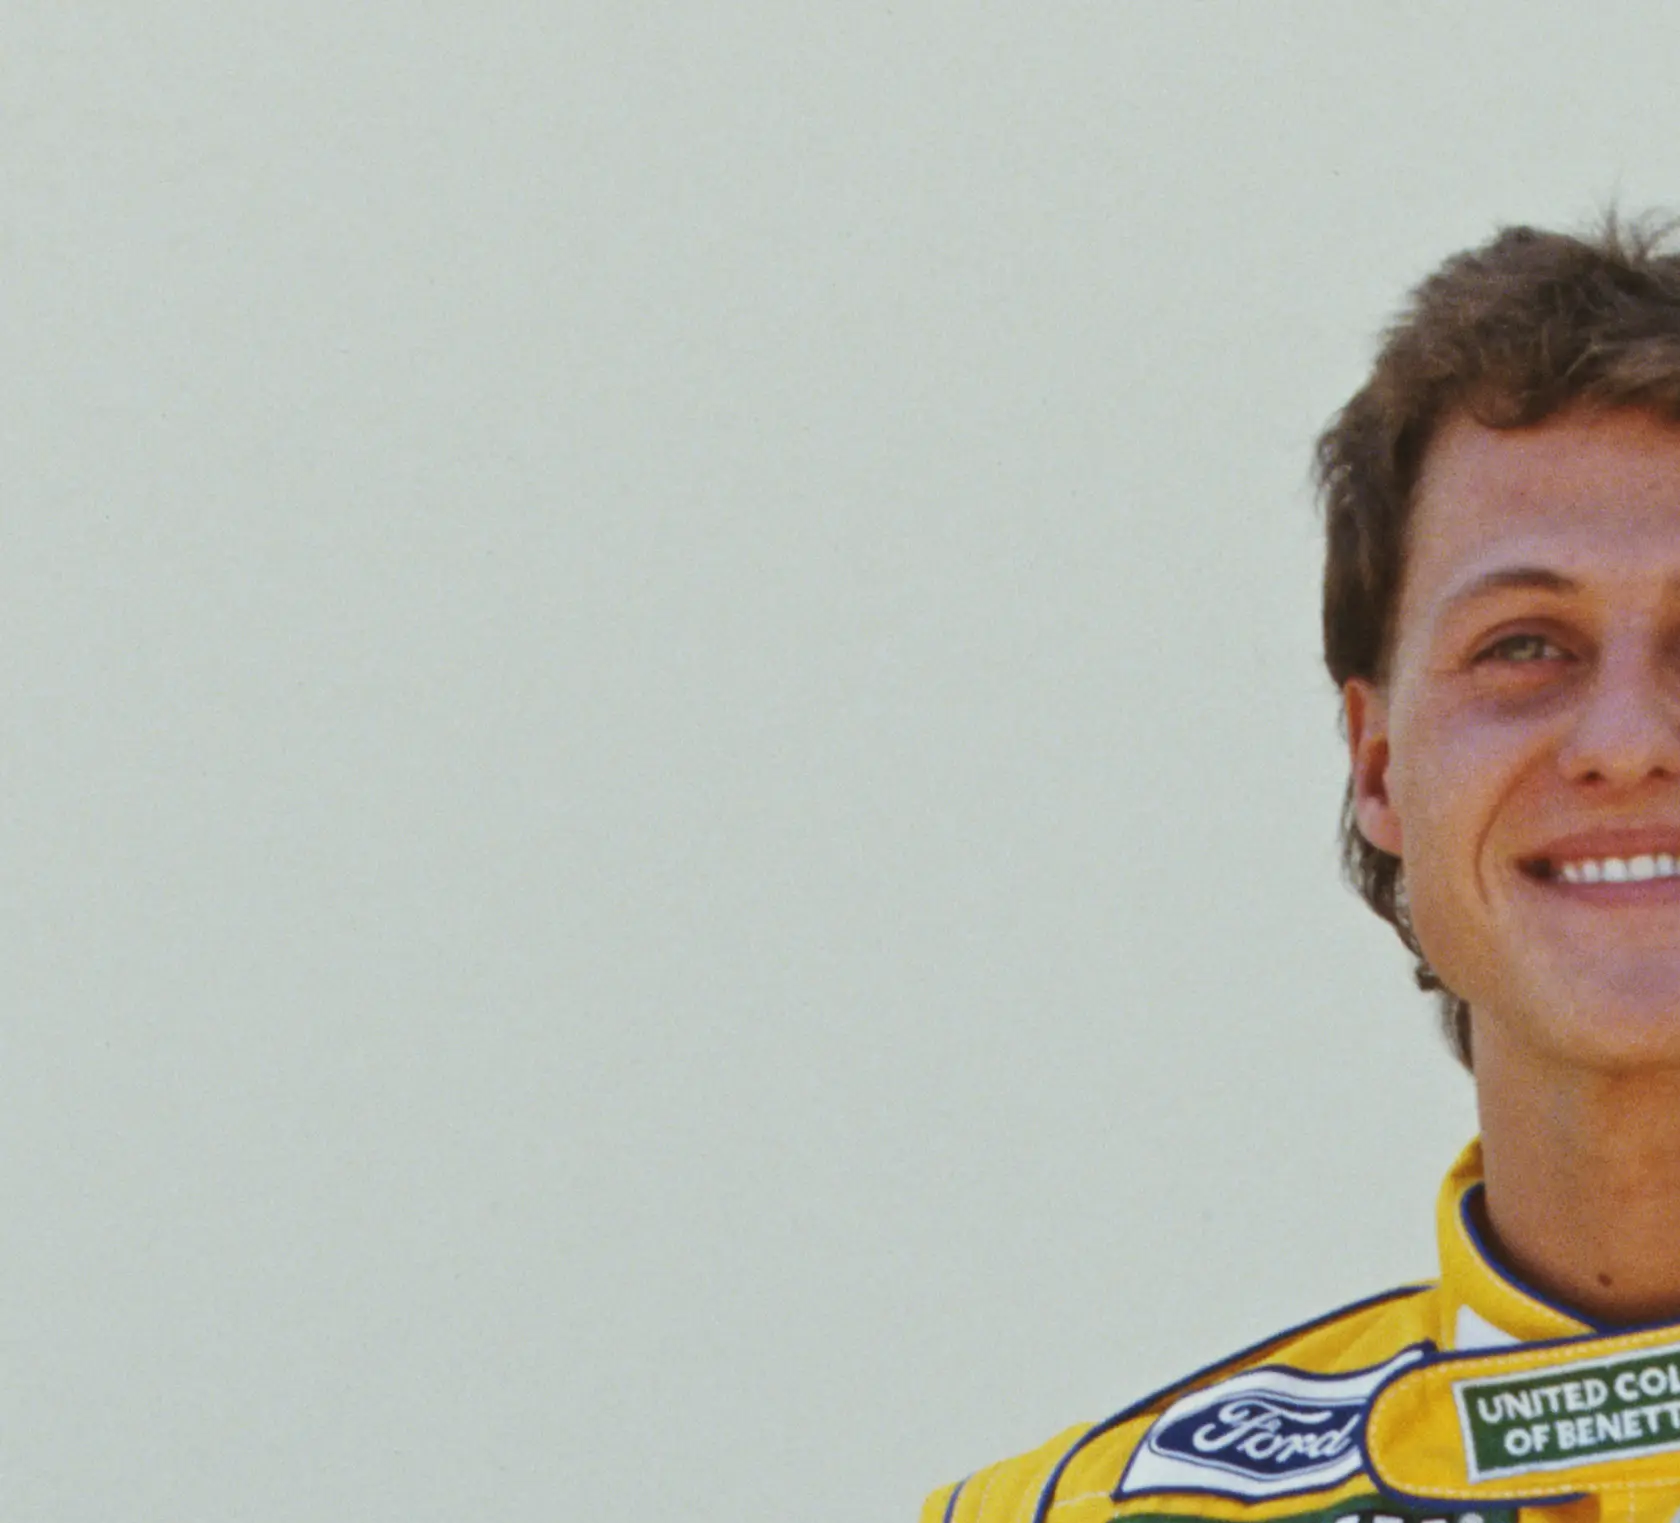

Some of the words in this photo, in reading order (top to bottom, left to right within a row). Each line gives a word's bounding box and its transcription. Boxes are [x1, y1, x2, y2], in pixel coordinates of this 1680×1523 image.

[1478, 1379, 1608, 1423] UNITED
[1193, 1400, 1361, 1463] Ford
[1504, 1424, 1550, 1456] OF
